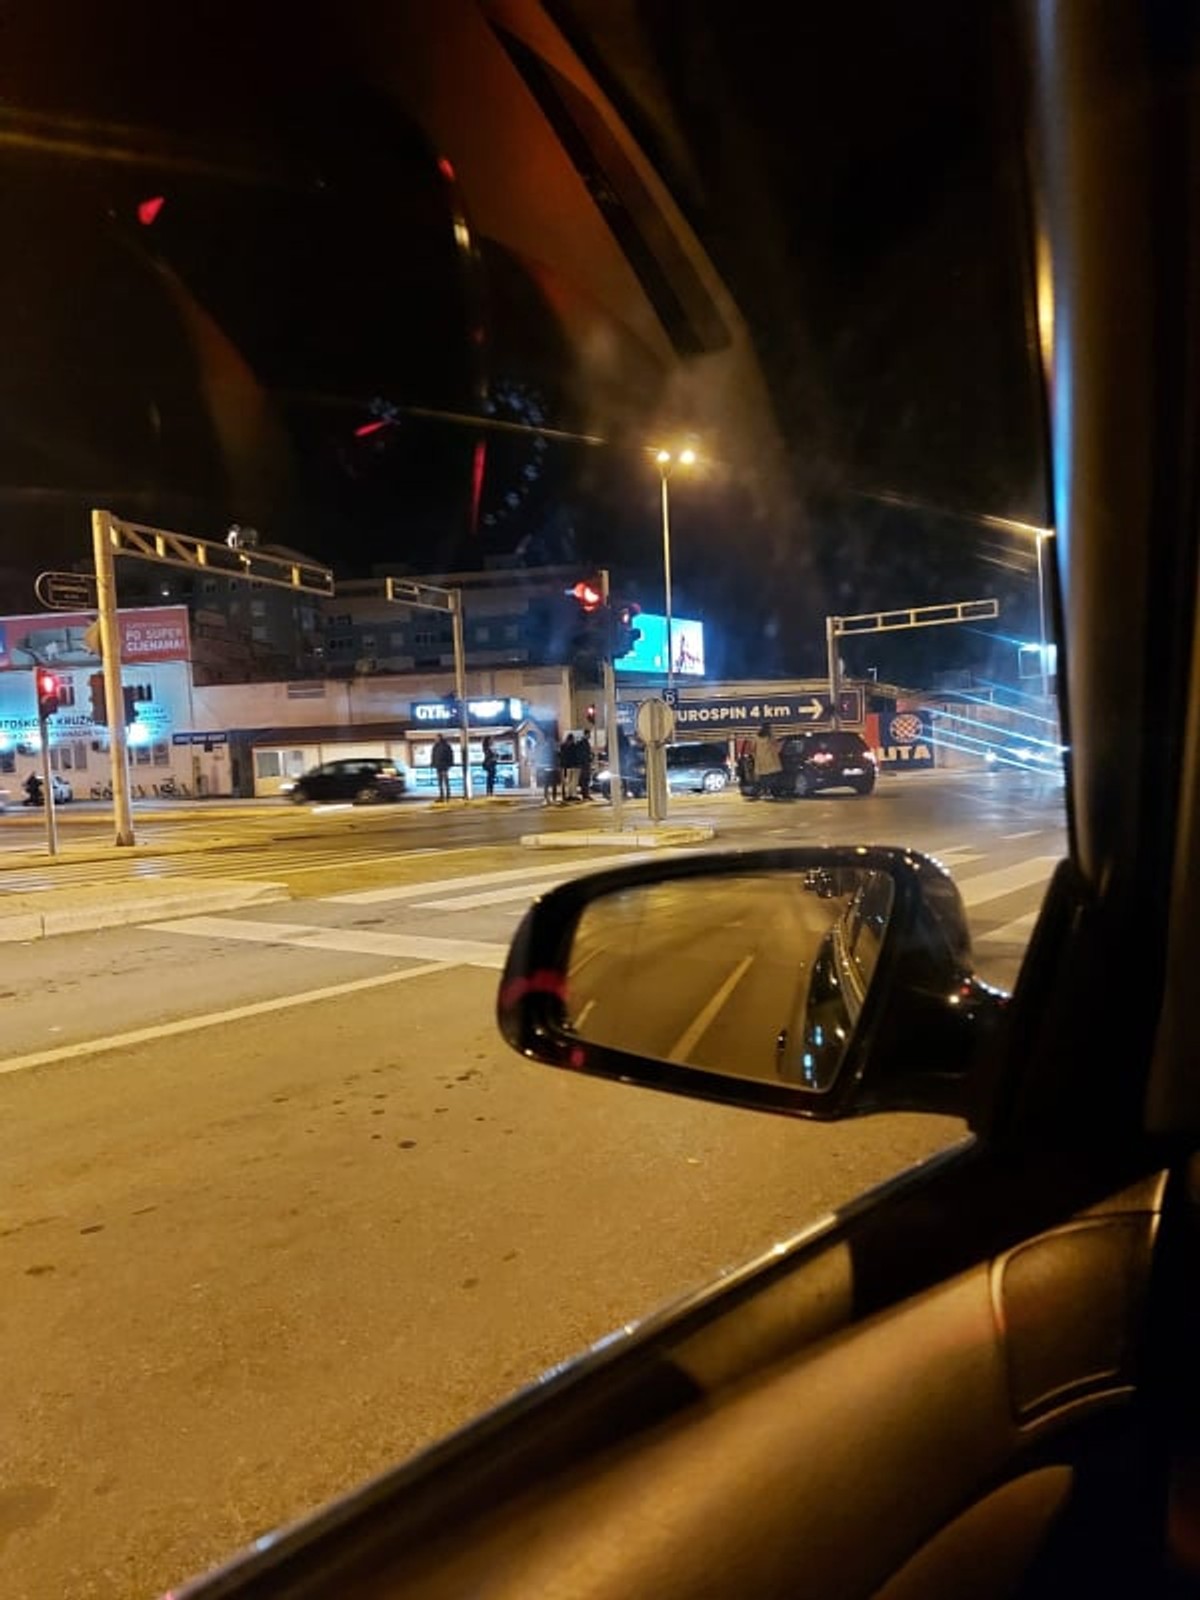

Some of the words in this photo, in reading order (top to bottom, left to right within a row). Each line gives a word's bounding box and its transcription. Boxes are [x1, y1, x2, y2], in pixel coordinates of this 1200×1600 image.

[674, 706, 747, 722] UROSPIN
[749, 704, 760, 718] 4
[763, 703, 791, 718] km
